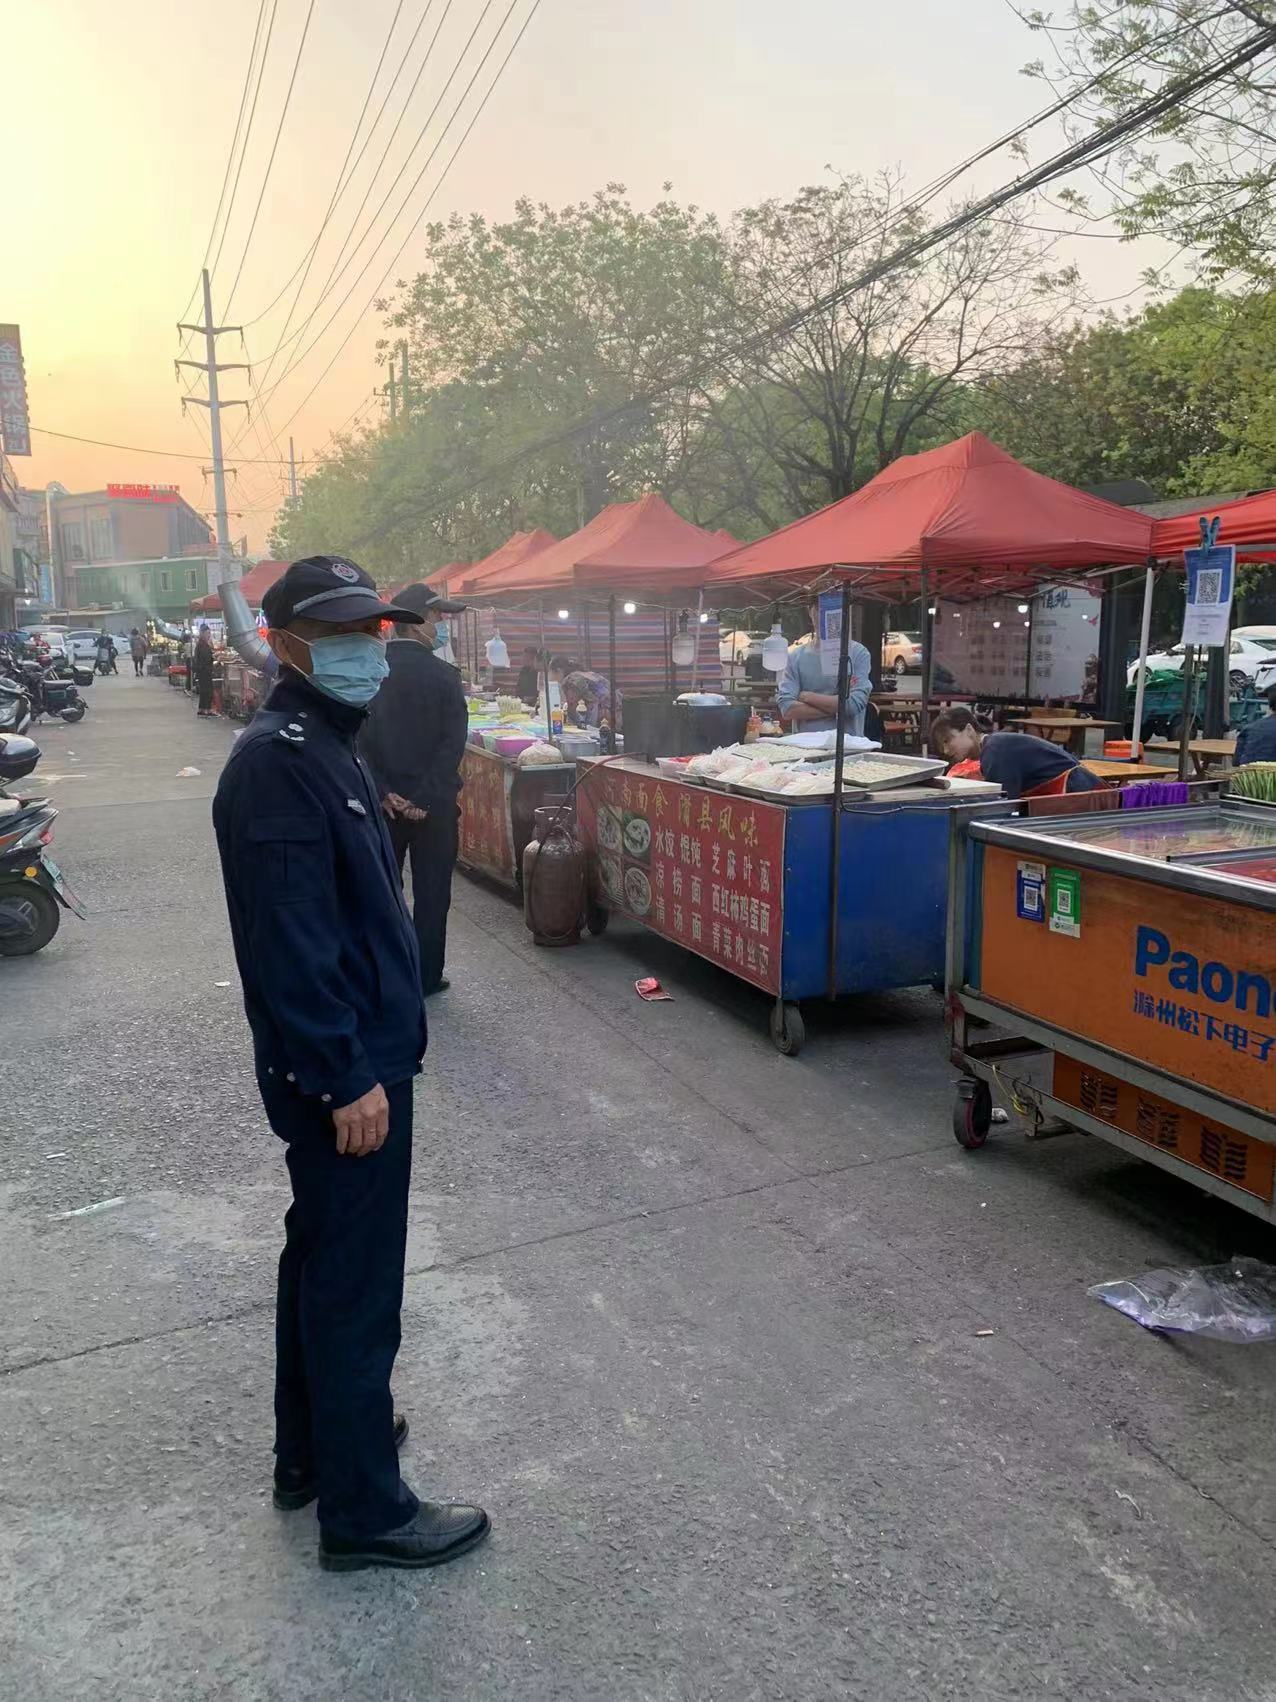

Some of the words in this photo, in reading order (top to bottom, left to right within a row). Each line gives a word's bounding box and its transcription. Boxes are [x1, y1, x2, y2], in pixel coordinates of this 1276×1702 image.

[679, 792, 759, 847] 滑县风味
[655, 825, 675, 858] 水饺
[680, 833, 702, 868] 馄饨
[711, 840, 771, 893] 芝麻叶面
[711, 883, 771, 936] 西红柿鸡蛋面
[711, 921, 770, 976] 青菜肉丝面
[1135, 925, 1276, 1018] Paon
[1133, 988, 1276, 1062] 滁州松下电子
